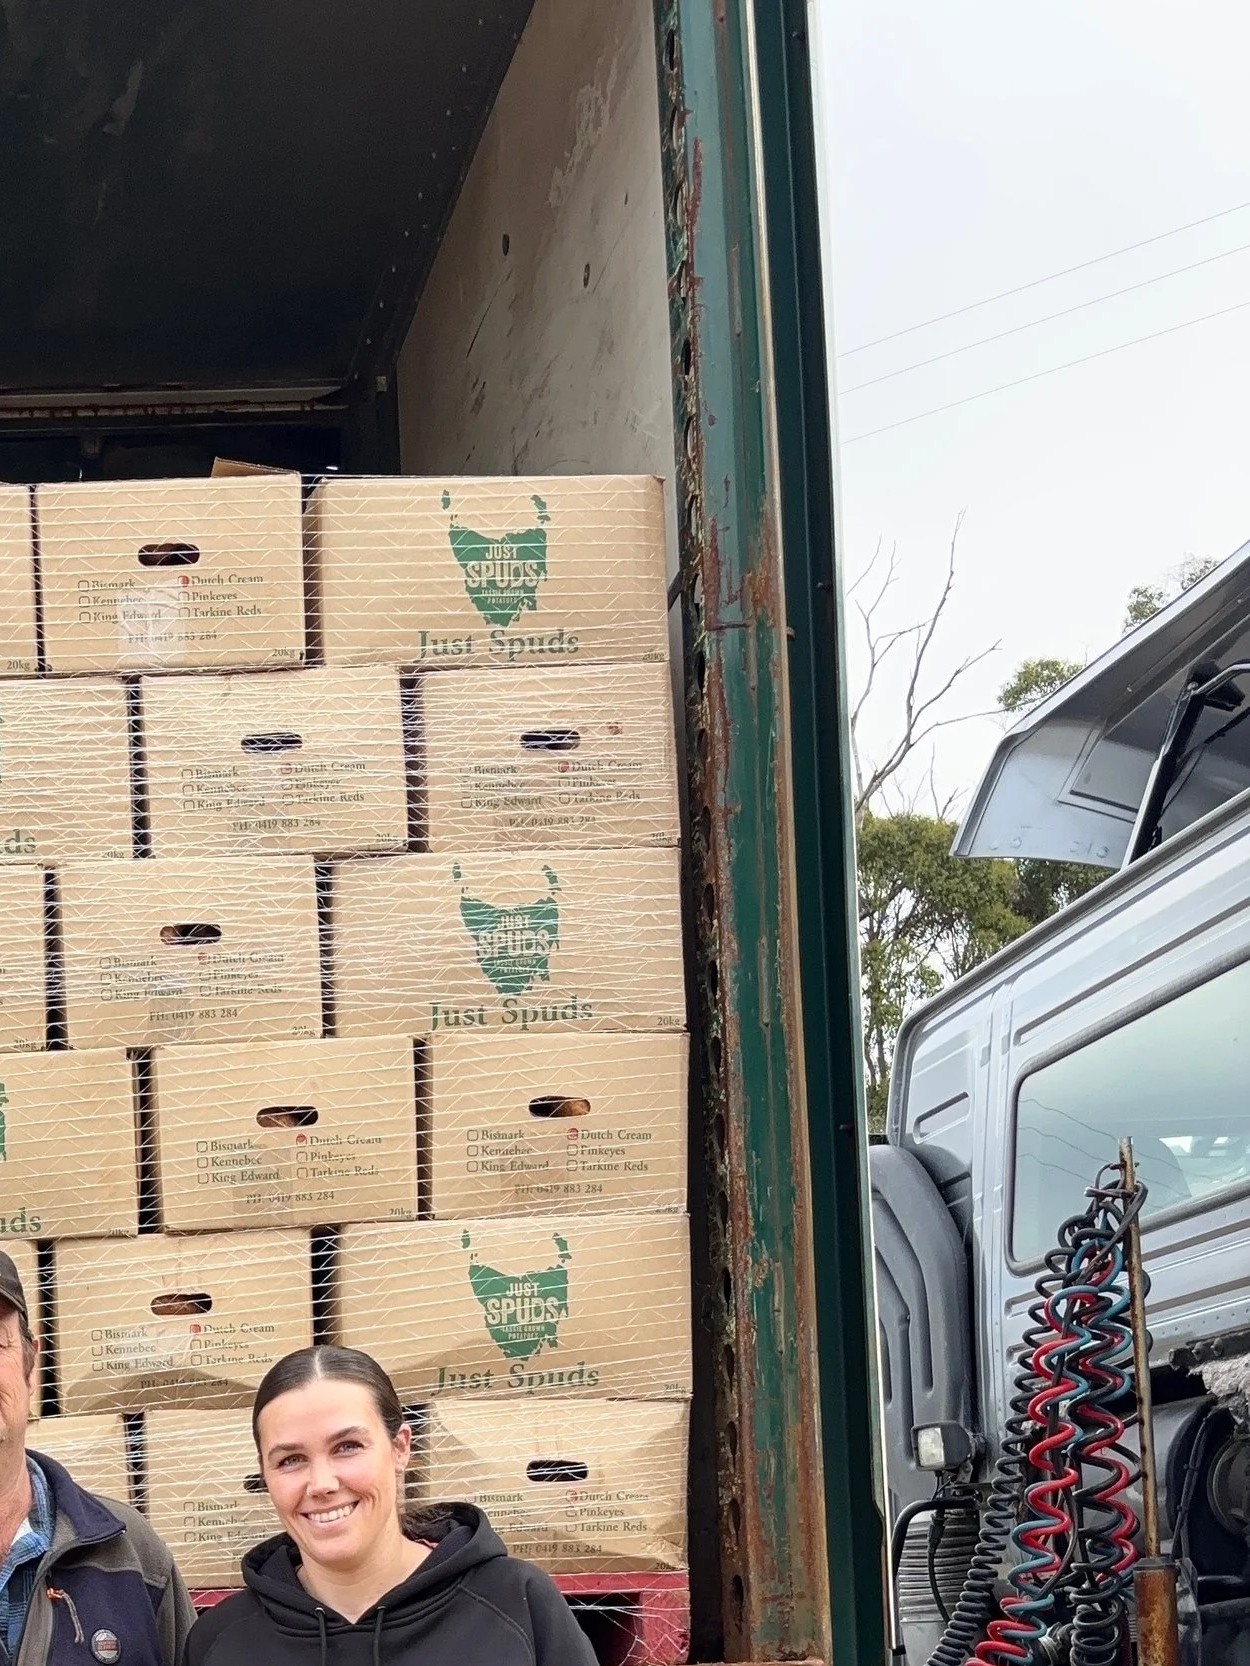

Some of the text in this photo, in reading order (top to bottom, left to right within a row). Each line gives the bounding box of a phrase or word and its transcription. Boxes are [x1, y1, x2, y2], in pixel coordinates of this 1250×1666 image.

[486, 544, 518, 560] JUST
[229, 573, 264, 585] Cream
[466, 560, 538, 587] SPUDS
[192, 605, 262, 618] Tarkine Reds
[414, 628, 579, 663] Just Spuds
[6, 660, 31, 672] 20kg
[281, 818, 299, 828] 883
[477, 930, 550, 956] SPUDS
[171, 1010, 195, 1020] 0419
[198, 1009, 216, 1019] 883
[220, 1009, 238, 1018] 284
[429, 996, 593, 1032] Just Spuds
[481, 1129, 525, 1140] Bismark
[580, 1130, 652, 1140] Dutch Cream
[580, 1145, 626, 1158] Pinkeyes
[210, 1154, 263, 1167] Kennebec
[623, 1160, 648, 1171] Reds
[481, 1161, 504, 1173] King
[211, 1169, 280, 1184] King Edward
[563, 1184, 603, 1193] 883 284
[295, 1191, 335, 1201] 883 284
[506, 1282, 540, 1297] JUST
[486, 1296, 559, 1324] SPUDS
[104, 1327, 148, 1339] Bismark
[104, 1342, 157, 1354] Kennebec
[105, 1358, 129, 1371] King
[430, 1362, 600, 1396] Just Spuds
[479, 1492, 523, 1503] Bismark
[578, 1507, 624, 1519] Pinkeyes
[578, 1521, 647, 1531] Tarkine Reds
[513, 1544, 531, 1553] PH:
[534, 1544, 558, 1553] 0419
[562, 1544, 579, 1553] 883
